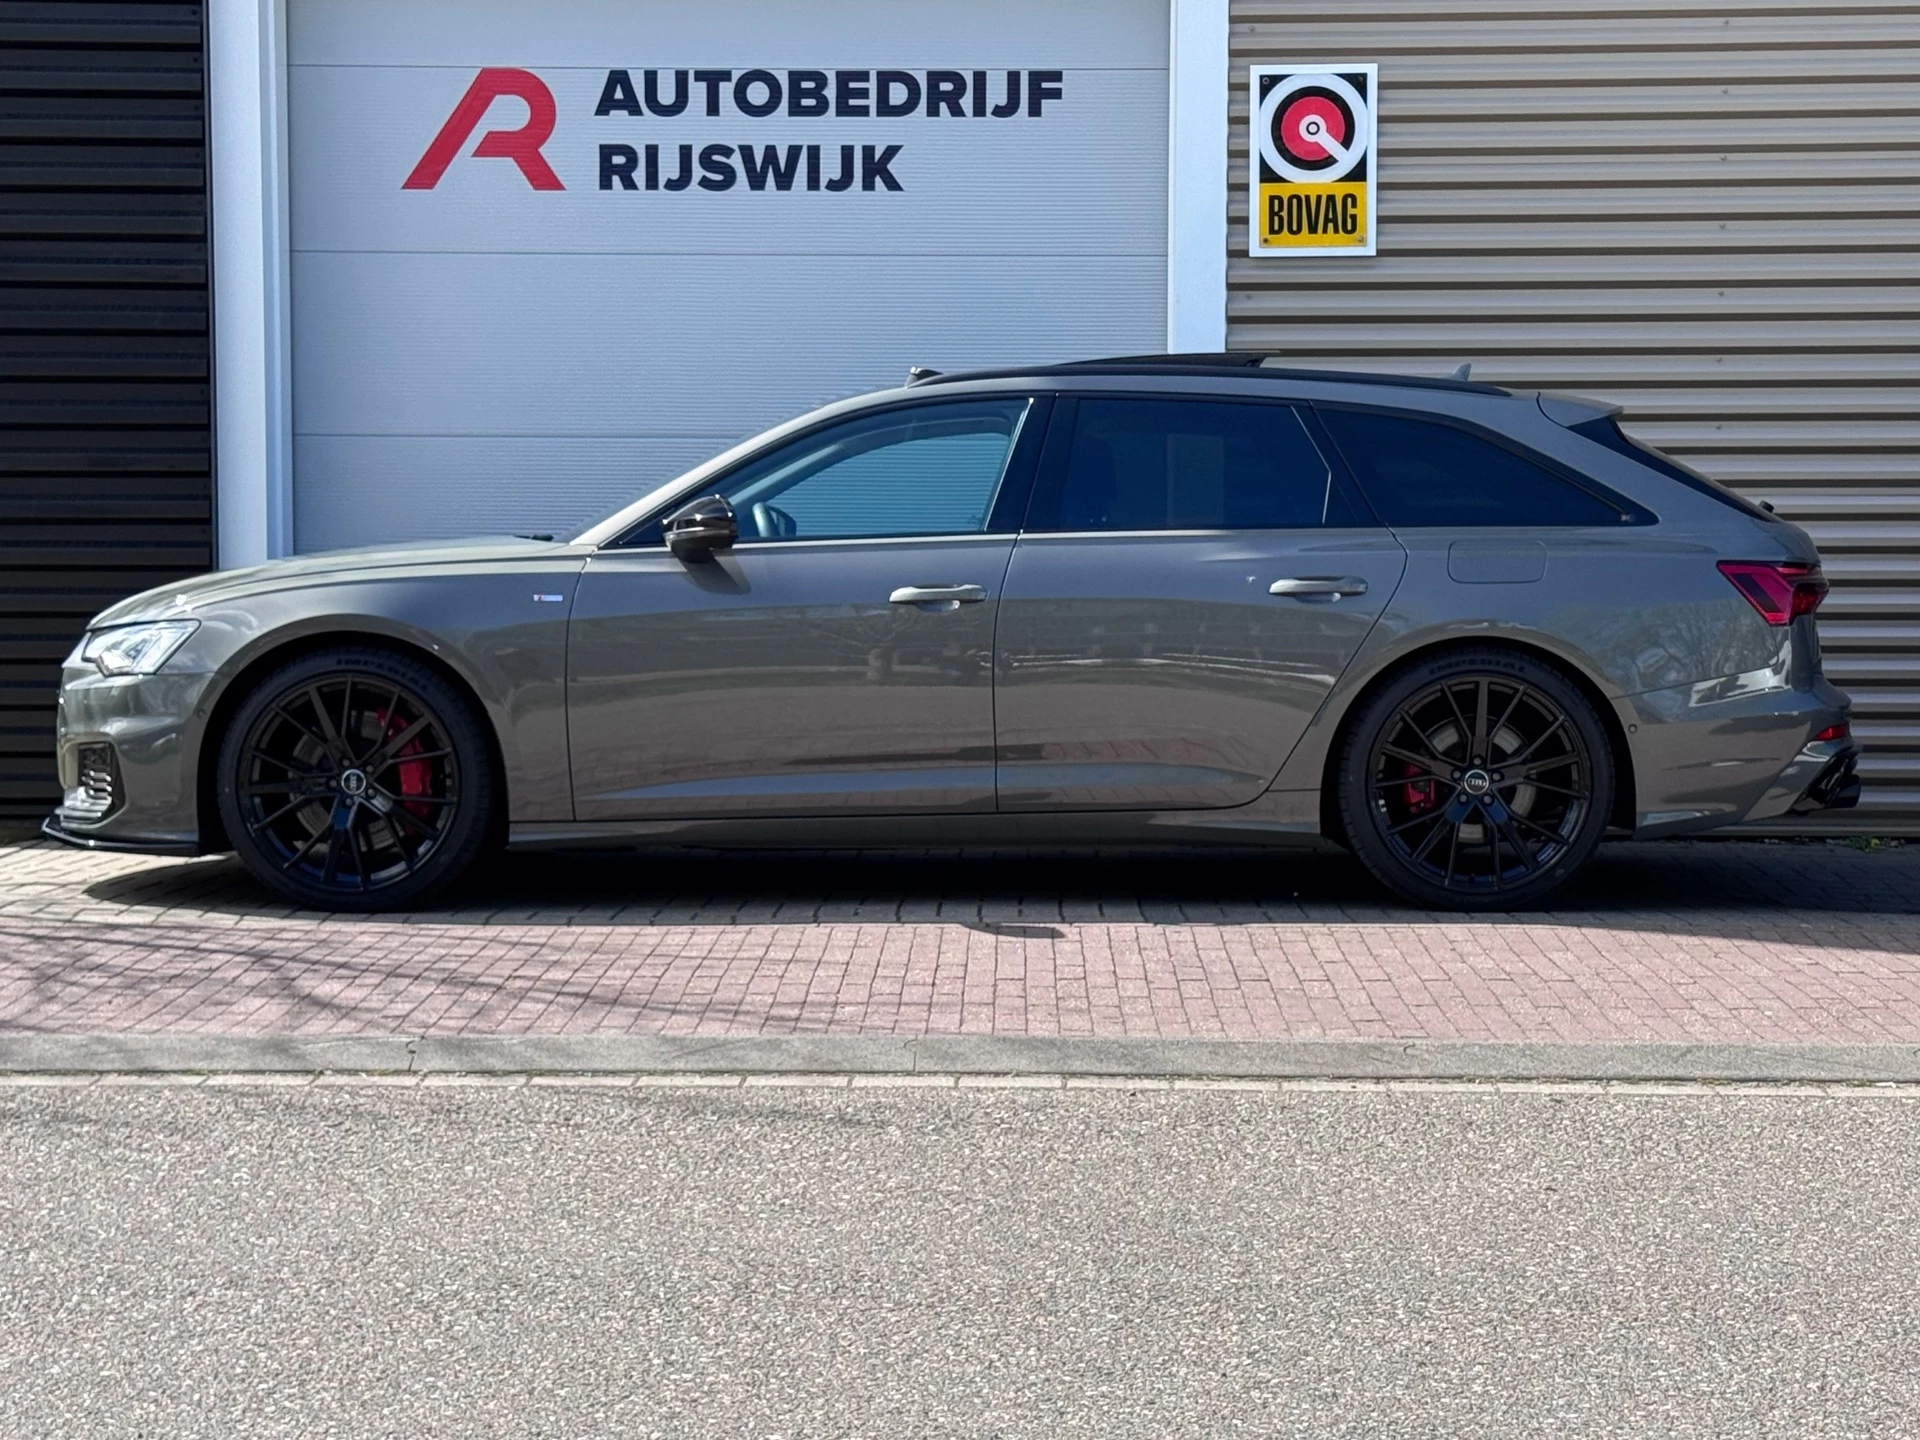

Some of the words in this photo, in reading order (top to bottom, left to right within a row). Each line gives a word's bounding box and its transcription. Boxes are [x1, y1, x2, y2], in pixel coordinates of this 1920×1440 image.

[594, 70, 1063, 118] AUTOBEDRIJF
[598, 144, 904, 192] RIJSWIJK
[1268, 193, 1358, 236] BOVAG
[1428, 657, 1526, 675] IMPERIAL
